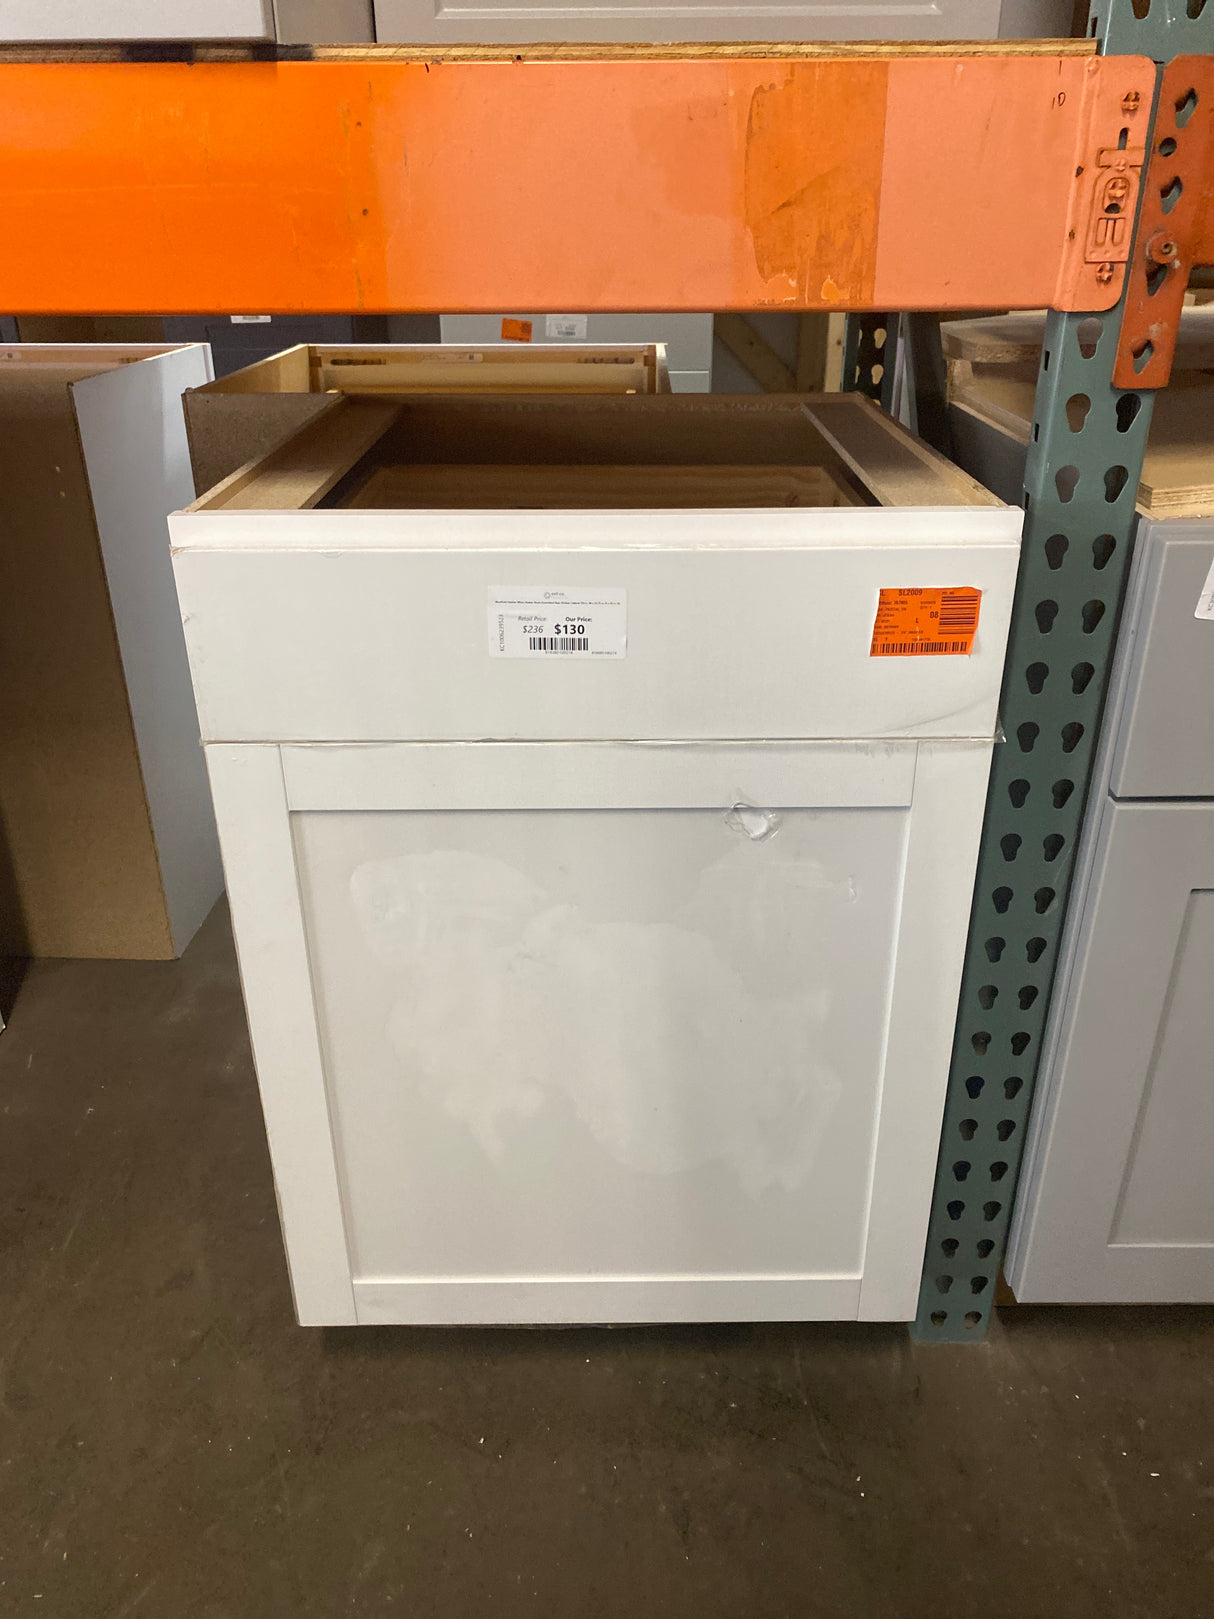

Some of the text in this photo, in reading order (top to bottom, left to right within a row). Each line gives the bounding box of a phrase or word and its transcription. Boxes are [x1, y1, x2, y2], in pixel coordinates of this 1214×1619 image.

[898, 588, 922, 596] SL2009
[523, 625, 544, 634] $236
[554, 623, 585, 635] $130
